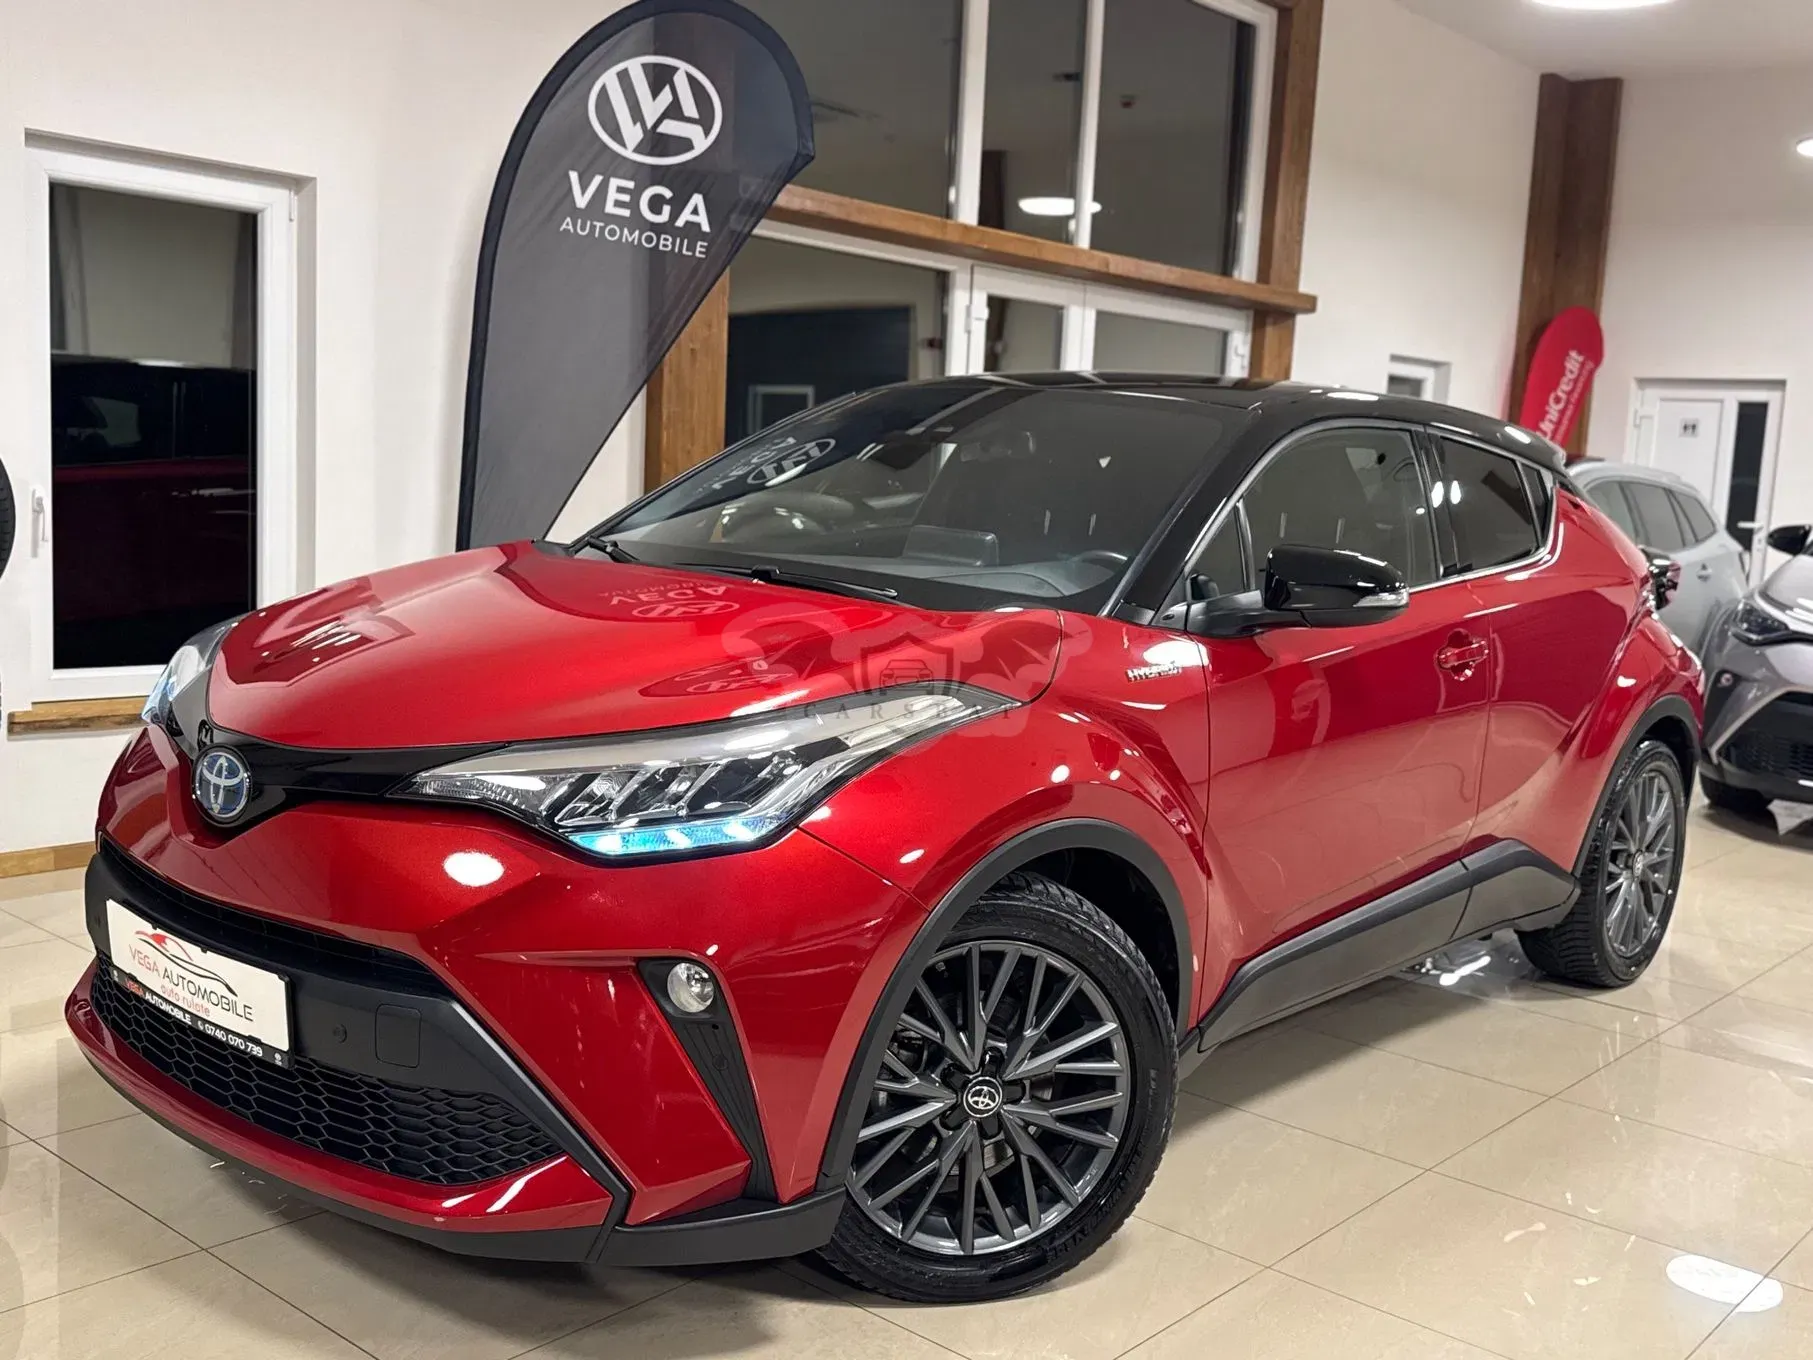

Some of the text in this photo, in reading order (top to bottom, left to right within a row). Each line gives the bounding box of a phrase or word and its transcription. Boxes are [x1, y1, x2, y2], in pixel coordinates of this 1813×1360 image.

[568, 170, 711, 233] VEGA
[560, 217, 708, 258] AUTOMOBILE
[129, 944, 254, 1022] VEGA AUTOMOBILE
[161, 984, 180, 1002] auto
[145, 991, 192, 1025] AUTOMOBILE
[205, 1024, 226, 1041] 0740
[228, 1034, 245, 1049] 070
[246, 1041, 263, 1057] 739
